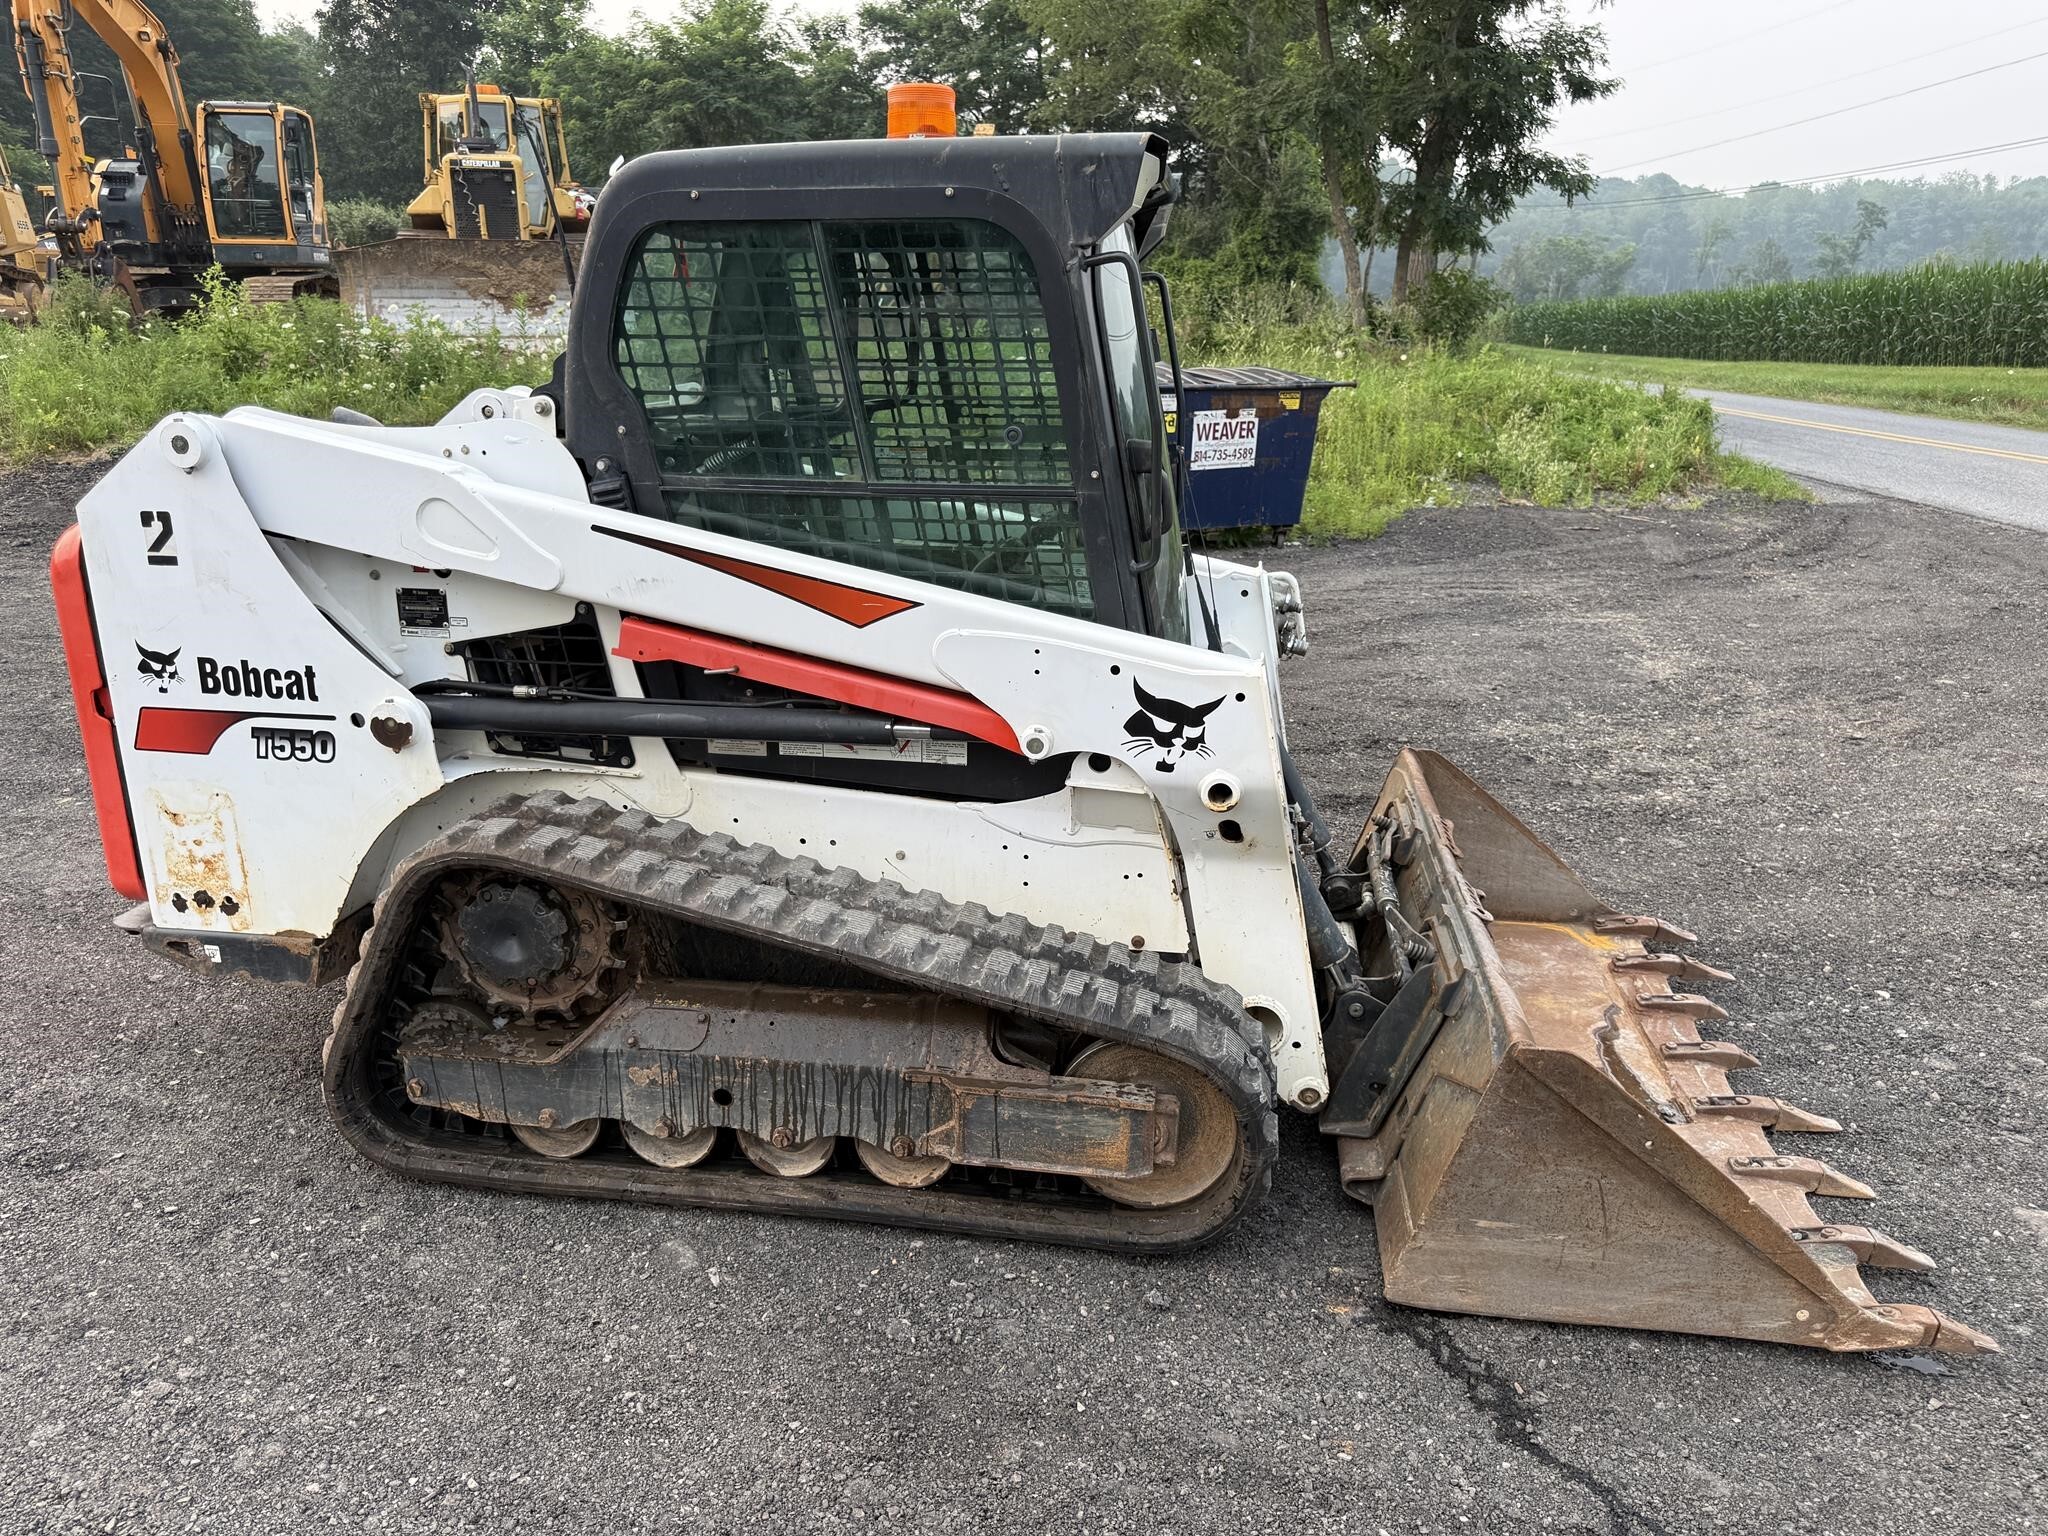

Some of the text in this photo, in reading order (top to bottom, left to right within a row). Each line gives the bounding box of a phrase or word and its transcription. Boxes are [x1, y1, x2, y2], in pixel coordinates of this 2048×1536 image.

[462, 159, 500, 167] CATERPILLAR
[1196, 420, 1255, 442] WEAVER
[1194, 447, 1254, 462] 814-735-4589
[140, 511, 178, 566] 2
[197, 656, 319, 702] Bobcat
[251, 726, 336, 763] T550
